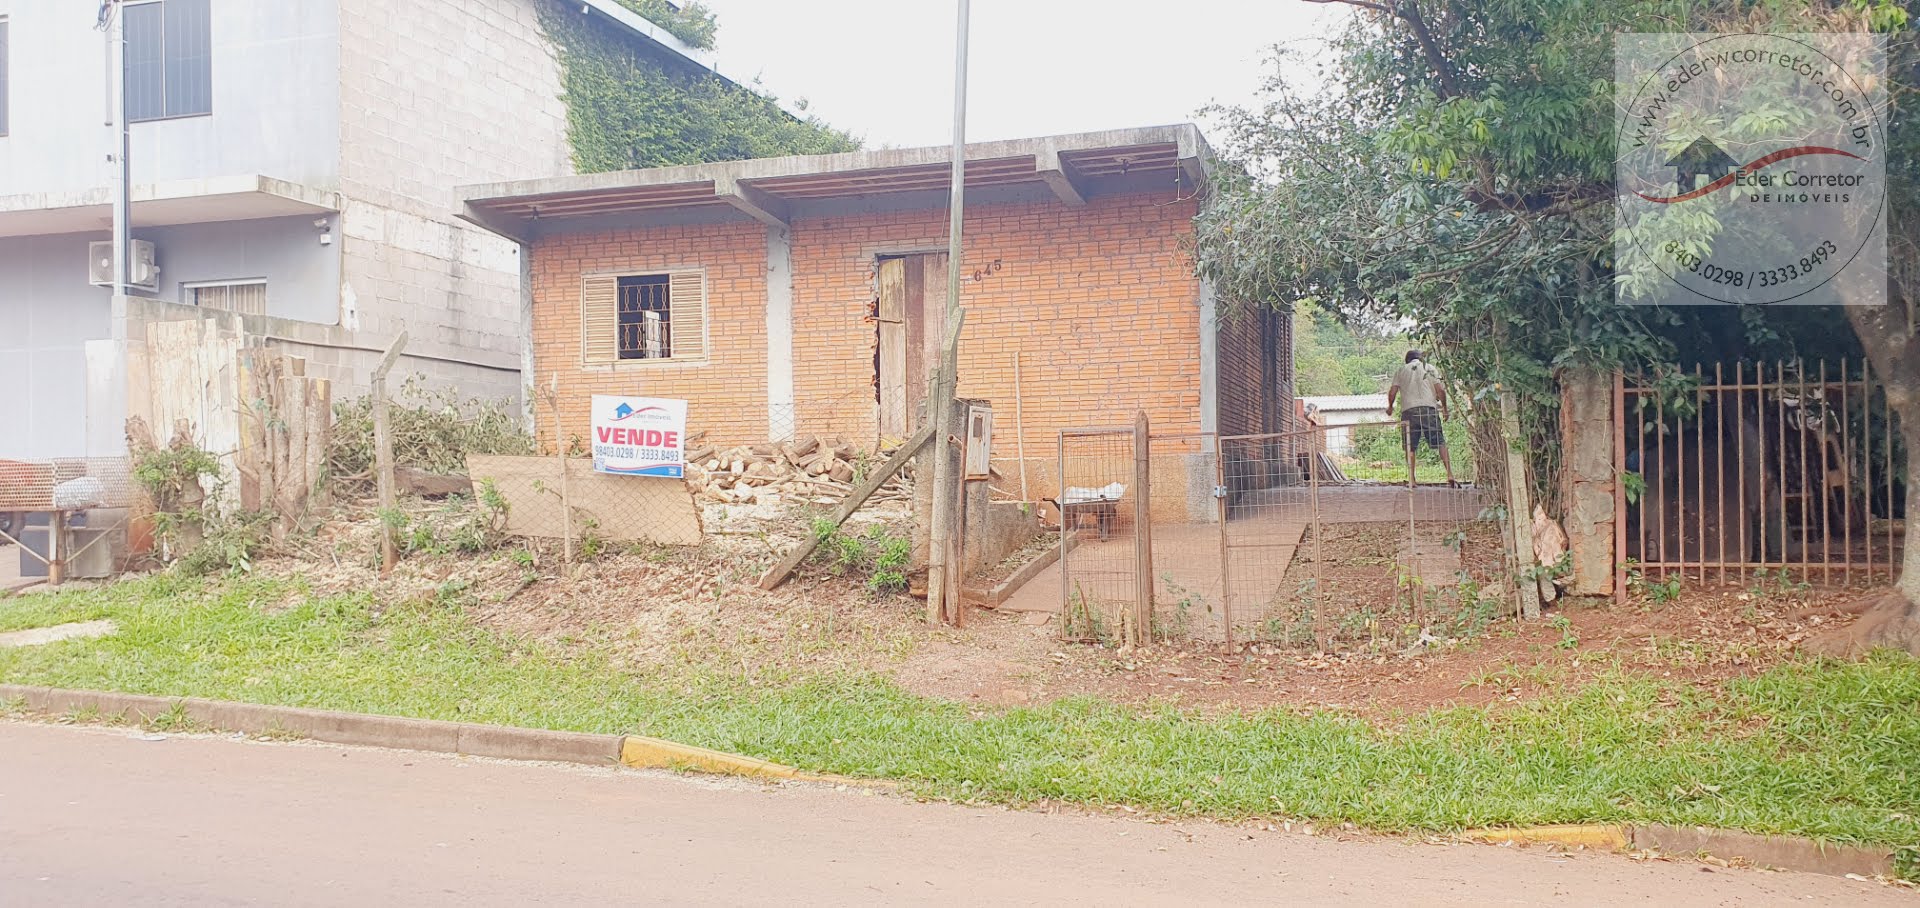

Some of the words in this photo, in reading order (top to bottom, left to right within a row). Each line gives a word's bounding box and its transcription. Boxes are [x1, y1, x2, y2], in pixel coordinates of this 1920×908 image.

[974, 259, 1002, 282] 645
[597, 426, 678, 448] VENDE
[595, 445, 634, 459] 98403.0298
[641, 448, 679, 462] 3333.8493
